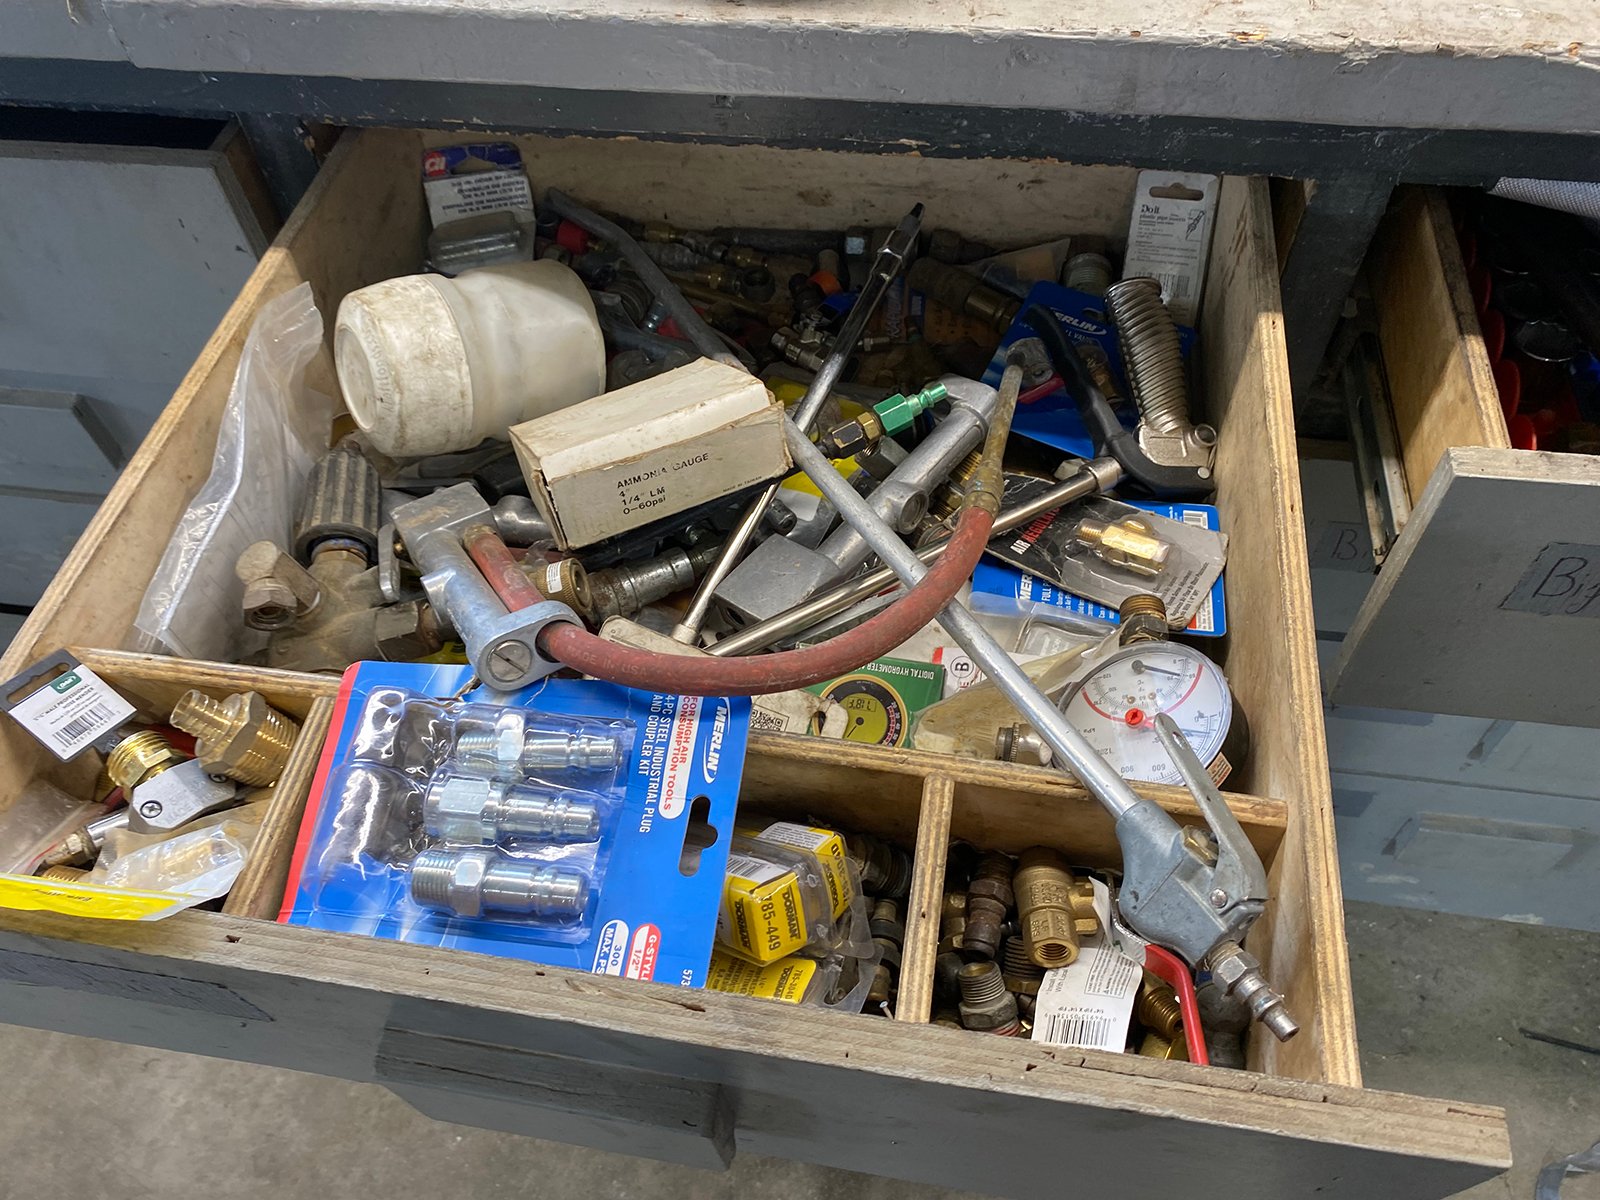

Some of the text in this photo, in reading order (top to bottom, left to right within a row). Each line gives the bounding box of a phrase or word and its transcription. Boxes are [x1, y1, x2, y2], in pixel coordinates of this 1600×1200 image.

[1055, 311, 1097, 331] ERLIN
[616, 452, 709, 489] AMMONIA GAUGE
[650, 486, 666, 498] LM
[1010, 540, 1031, 556] AIR
[1019, 574, 1033, 600] MER
[868, 662, 910, 676] HYGROMETER
[910, 668, 934, 680] DIGITAL
[954, 662, 970, 672] B
[638, 695, 664, 776] AND COUPLER KIT
[680, 697, 698, 764] FOR HIGH AIR
[708, 706, 728, 774] MERLIN
[639, 695, 675, 833] 4-PC STEEL INDUSTRIAL PLUG
[664, 697, 690, 810] CONSUMPTION TOOLS
[735, 898, 752, 951] DORMAN
[782, 890, 799, 942] DORMAN
[596, 928, 614, 975] MAX. PS
[610, 945, 622, 966] 300
[632, 950, 642, 972] 1/2"
